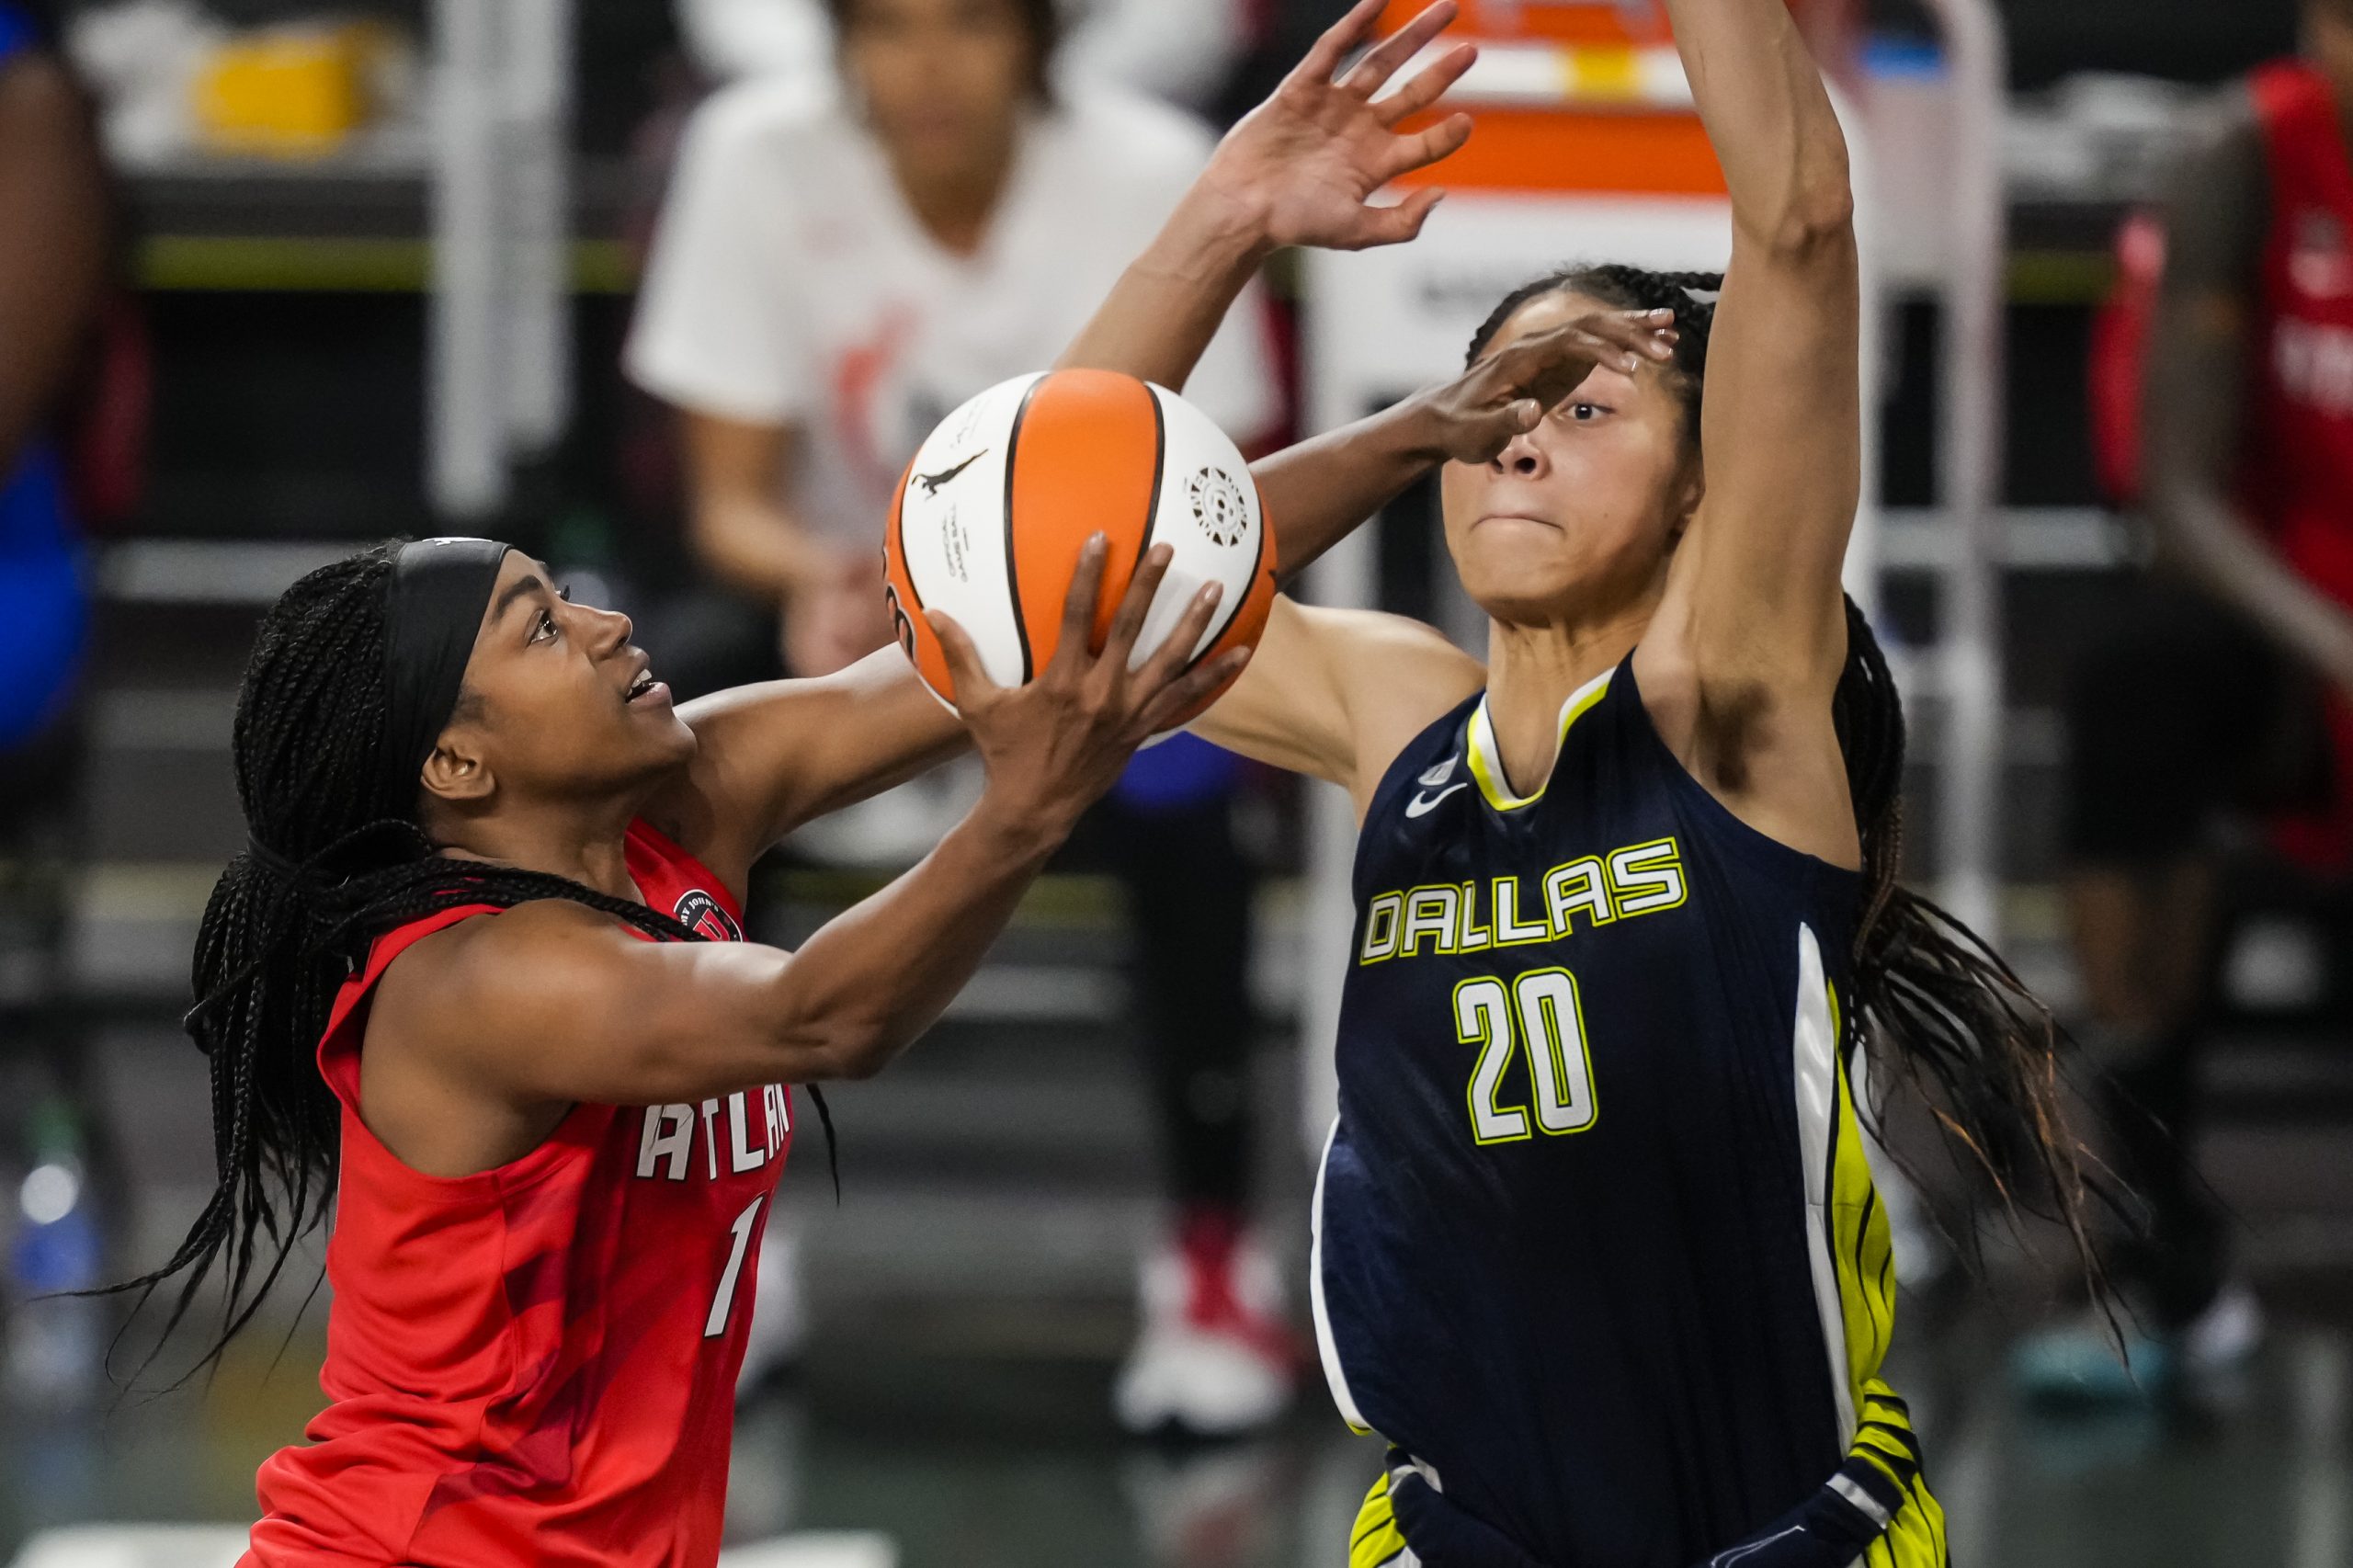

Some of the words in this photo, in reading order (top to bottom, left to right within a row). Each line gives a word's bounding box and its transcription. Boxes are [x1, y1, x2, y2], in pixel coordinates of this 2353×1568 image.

[1359, 836, 1688, 965] DALLAS
[1452, 966, 1598, 1145] 20
[703, 1196, 765, 1338] 1
